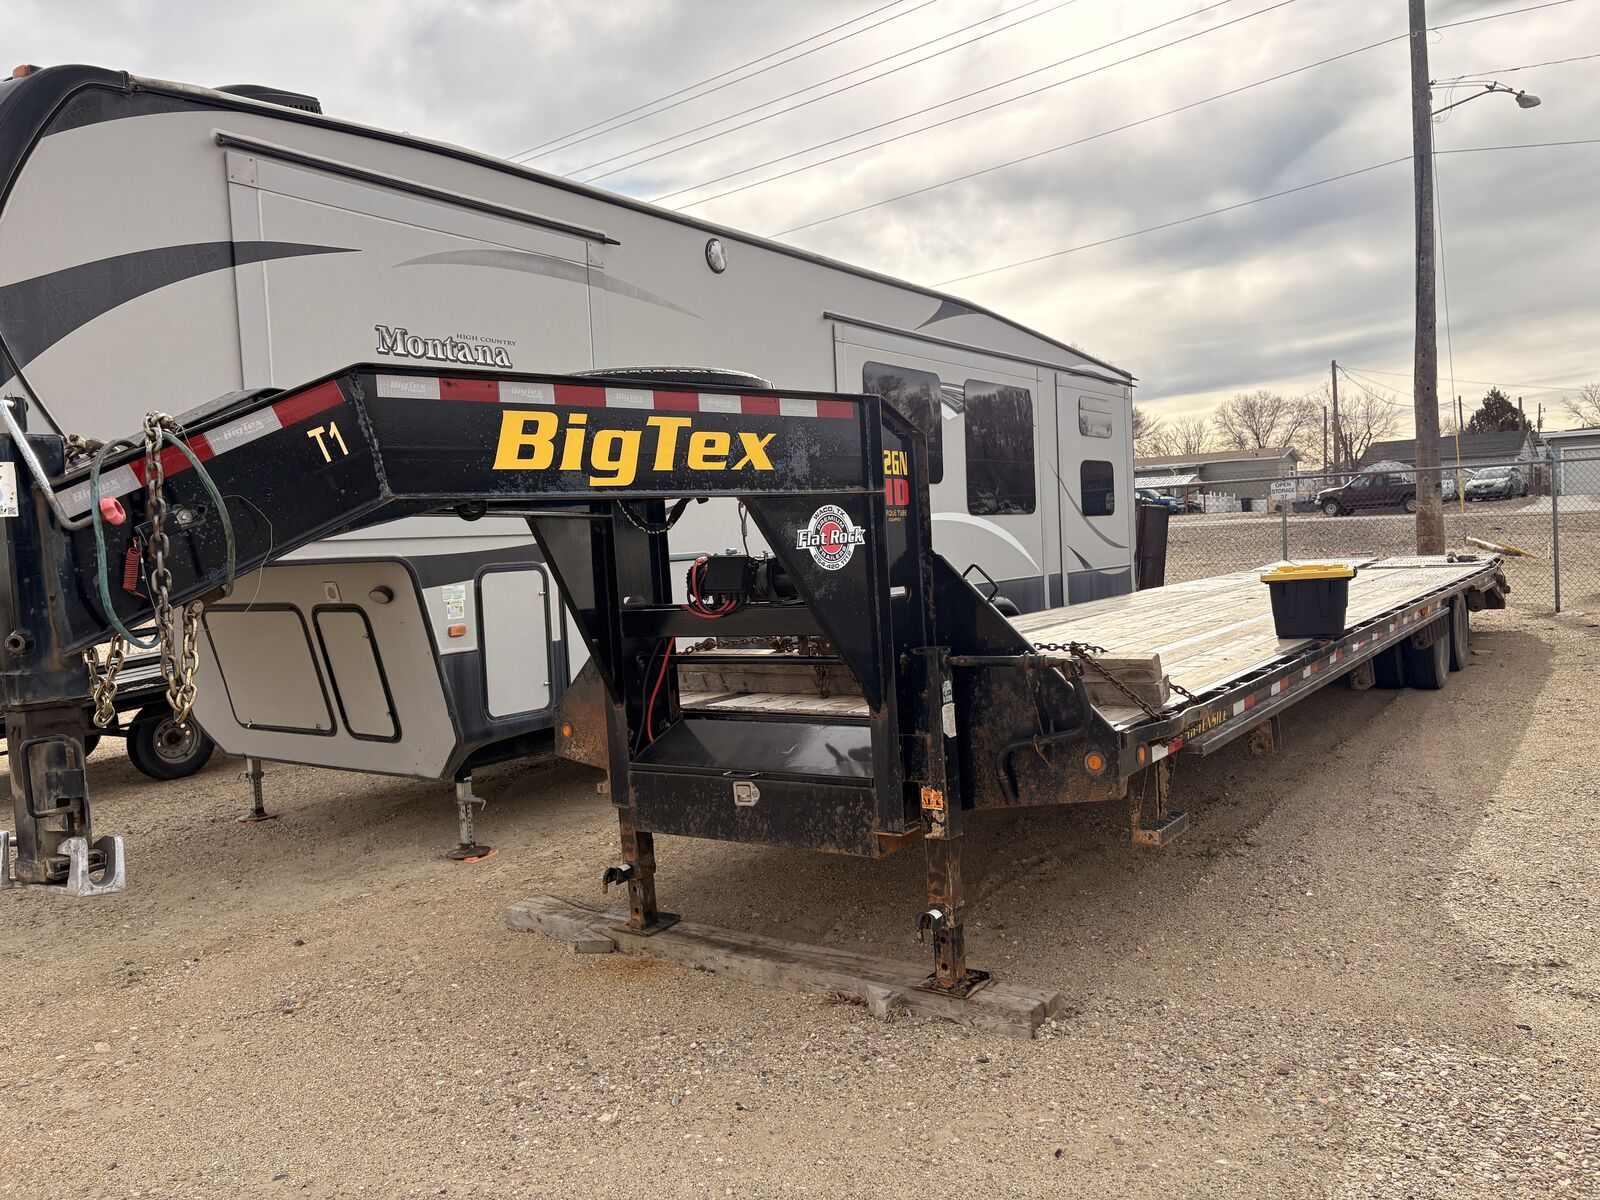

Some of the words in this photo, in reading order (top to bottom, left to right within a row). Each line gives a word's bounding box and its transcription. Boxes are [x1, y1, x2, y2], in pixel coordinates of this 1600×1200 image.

[375, 324, 513, 369] Montana
[456, 333, 478, 342] HIGH
[480, 336, 517, 347] COUNTRY
[306, 421, 349, 463] T1
[492, 410, 778, 487] BigTex
[813, 506, 835, 520] WACO,
[817, 515, 845, 530] PREMIUM
[798, 531, 828, 547] Flat
[829, 528, 864, 545] Rock
[819, 545, 847, 561] TRAILERS
